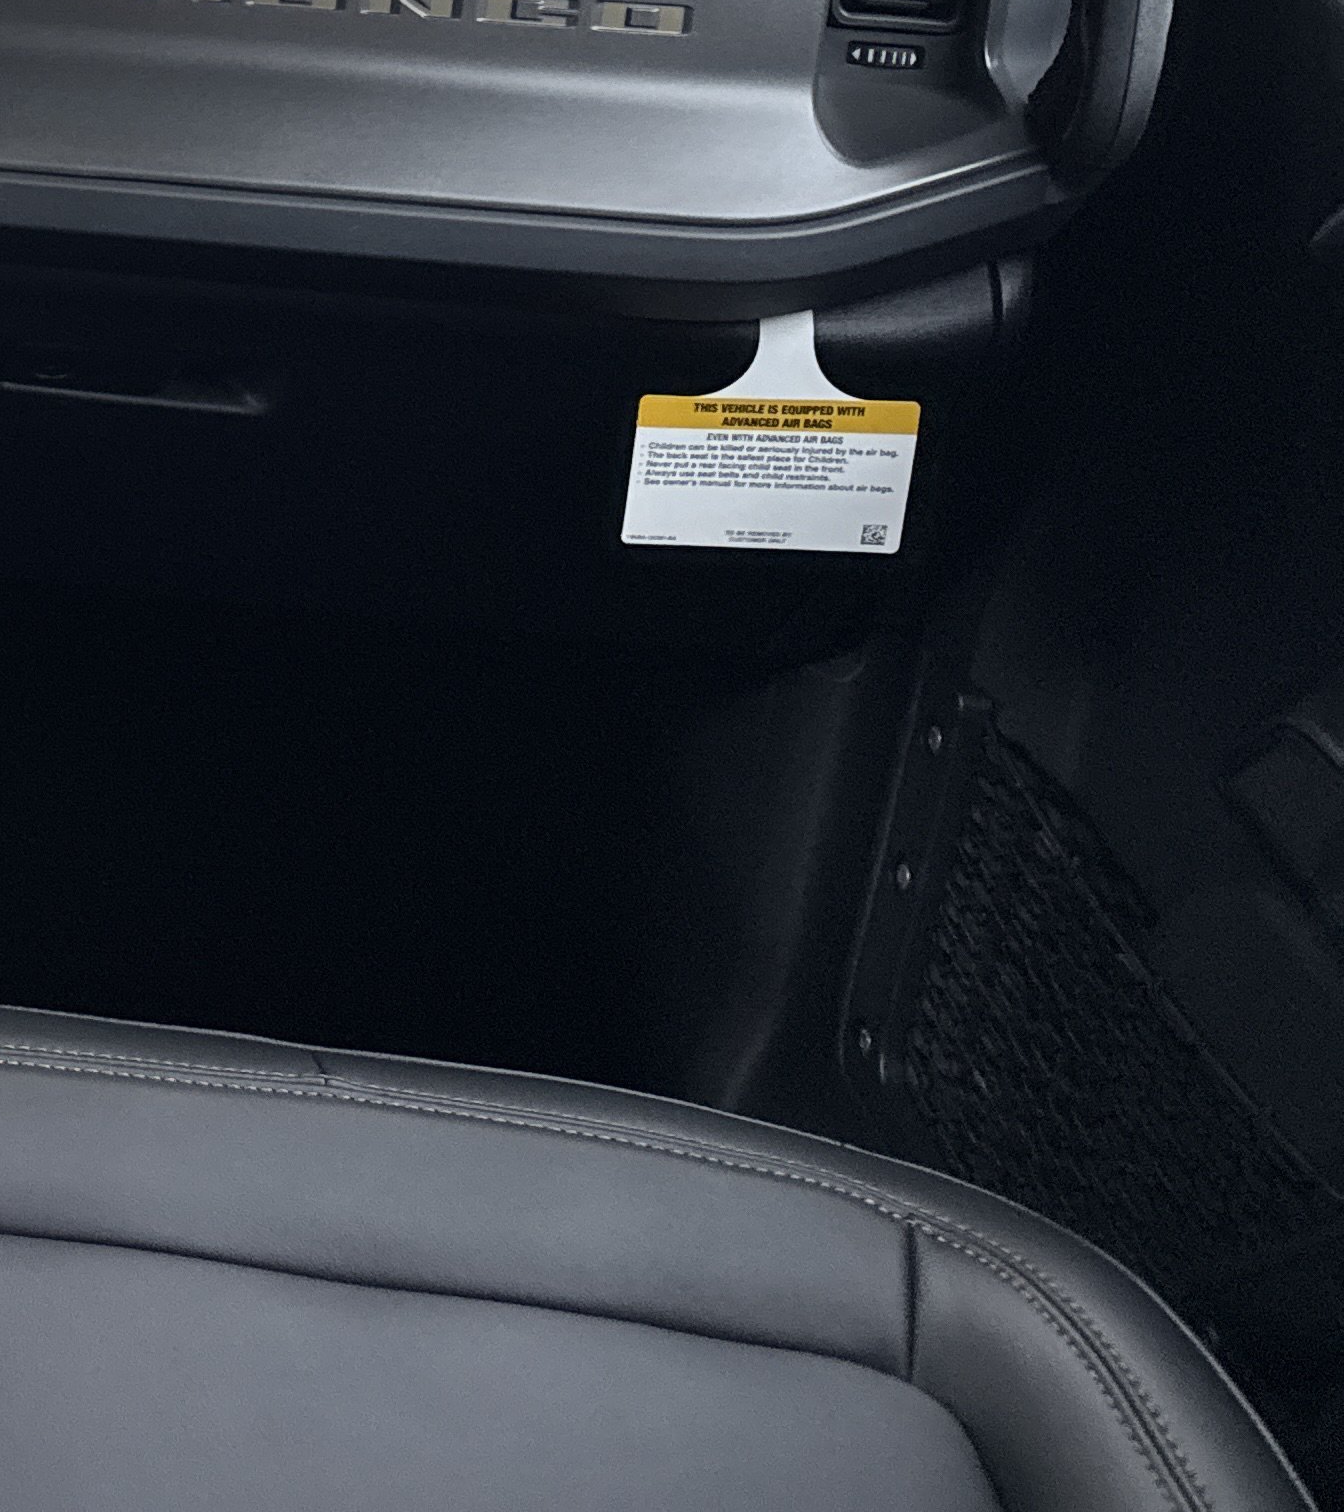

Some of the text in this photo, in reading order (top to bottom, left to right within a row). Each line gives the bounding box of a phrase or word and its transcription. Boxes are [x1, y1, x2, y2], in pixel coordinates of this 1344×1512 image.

[693, 402, 866, 417] THIS VEHICLE IS EQUIPPED WITH
[721, 417, 833, 429] ADVANCED AIR BAGS
[706, 433, 844, 445] EVEN WITH ADVANCED AIR BAGS
